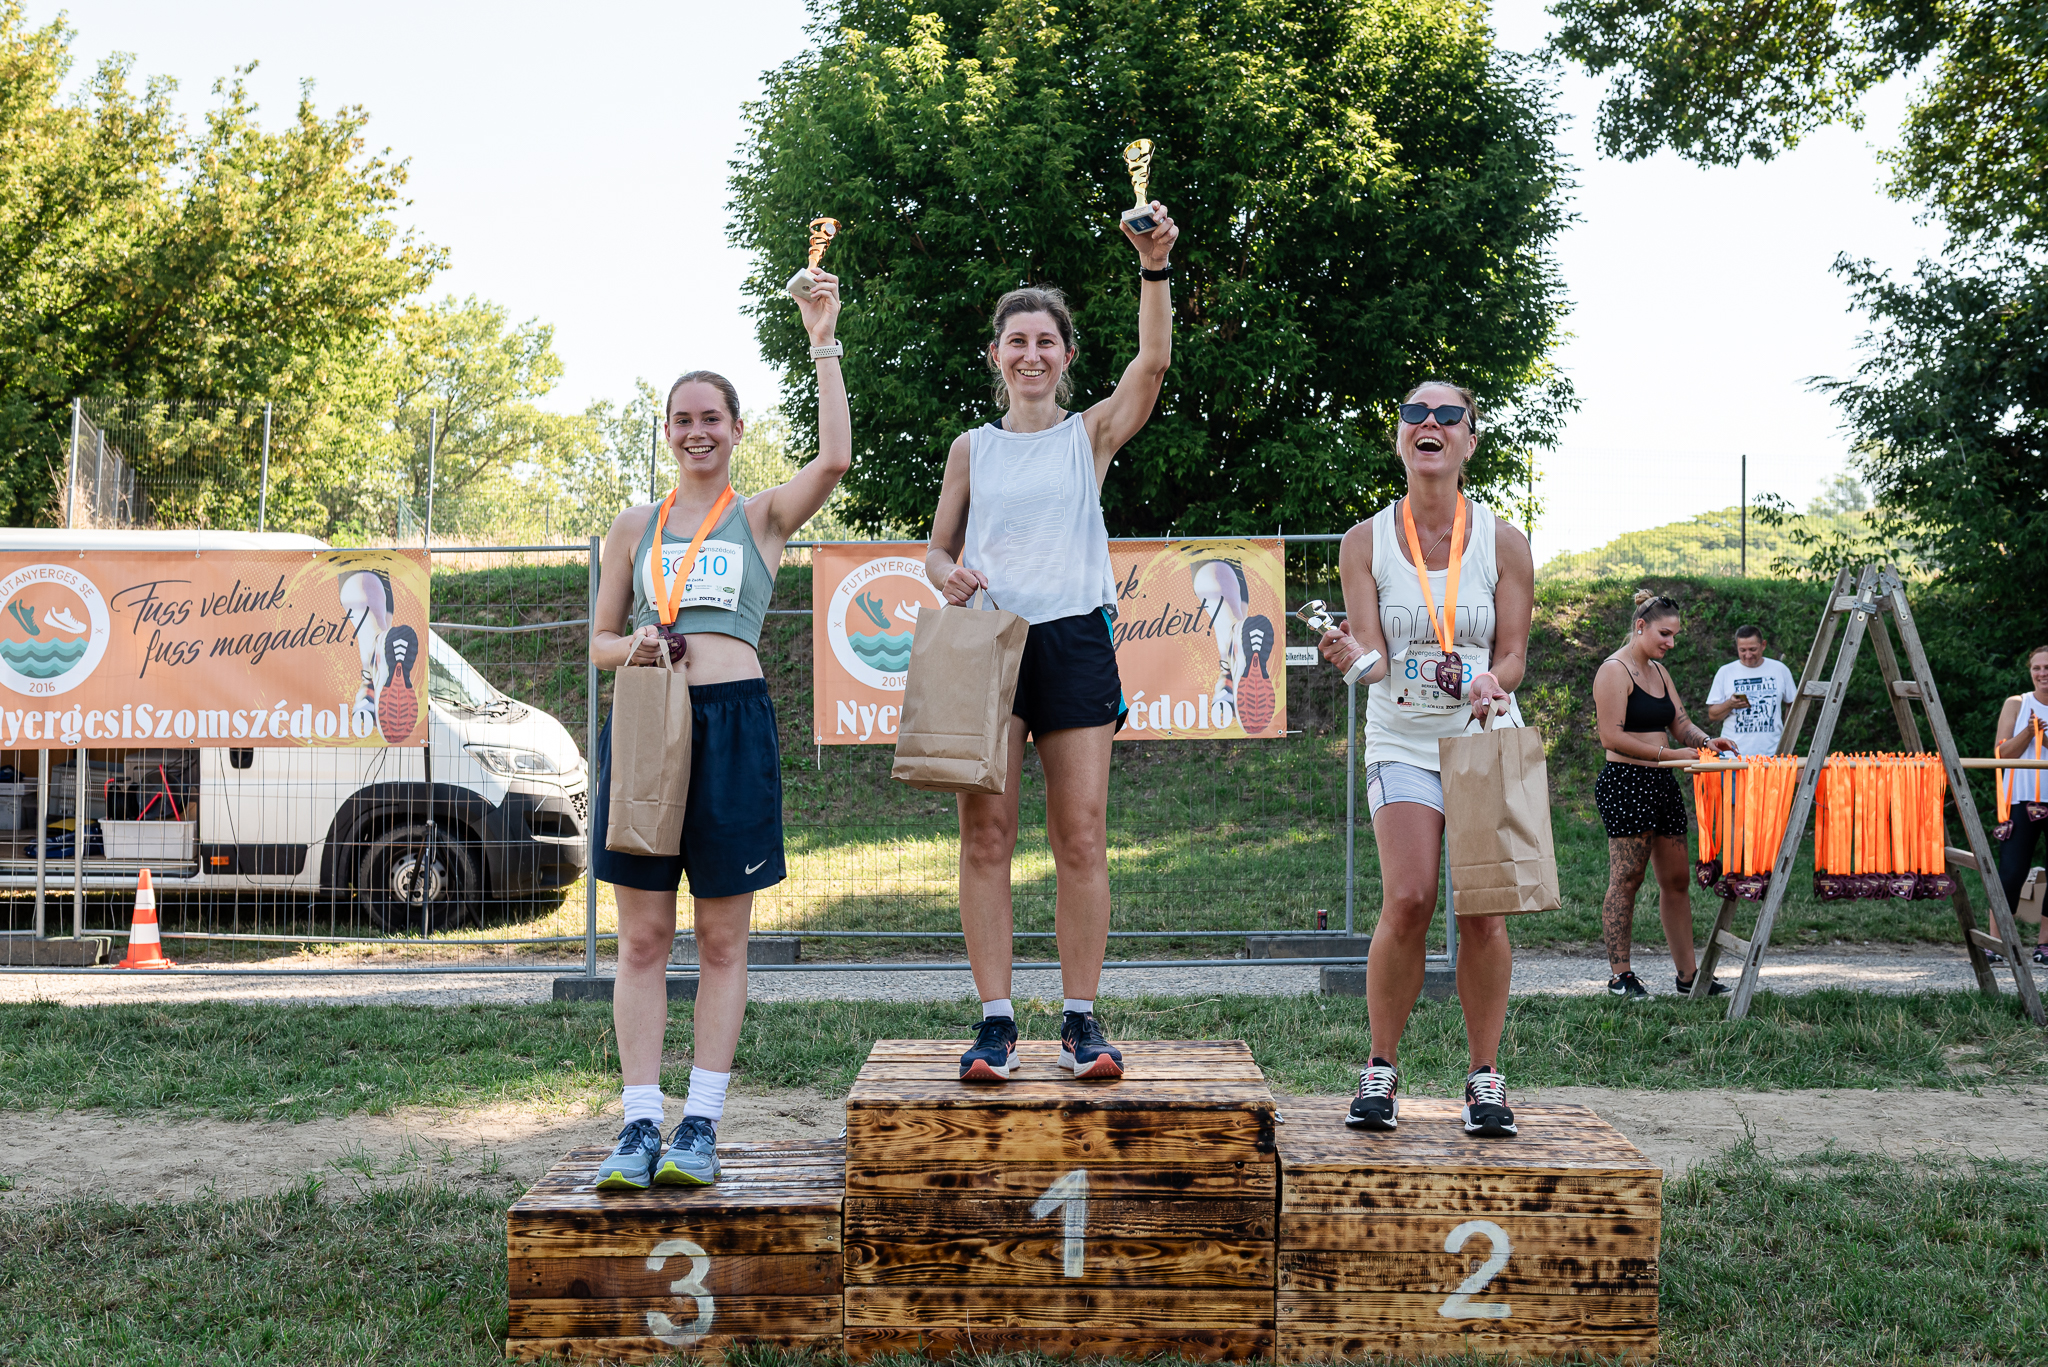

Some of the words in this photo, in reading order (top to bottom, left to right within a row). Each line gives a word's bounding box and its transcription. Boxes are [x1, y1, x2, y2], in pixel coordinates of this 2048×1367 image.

[0, 568, 78, 597] UTANYERGES
[79, 583, 95, 599] SE
[110, 580, 192, 635] Fuss
[200, 575, 293, 618] velünk.
[139, 629, 204, 679] fuss
[209, 606, 370, 665] magadért!
[1115, 596, 1224, 653] gadért!
[29, 682, 56, 693] 2016
[882, 675, 906, 687] 2016
[1405, 659, 1473, 683] 803
[0, 699, 374, 747] yergesiSzomszédoló
[836, 700, 902, 742] Nye
[1121, 690, 1234, 731] édoló
[1030, 1170, 1087, 1278] 1
[646, 1240, 715, 1345] 3
[1438, 1220, 1515, 1319] 2
